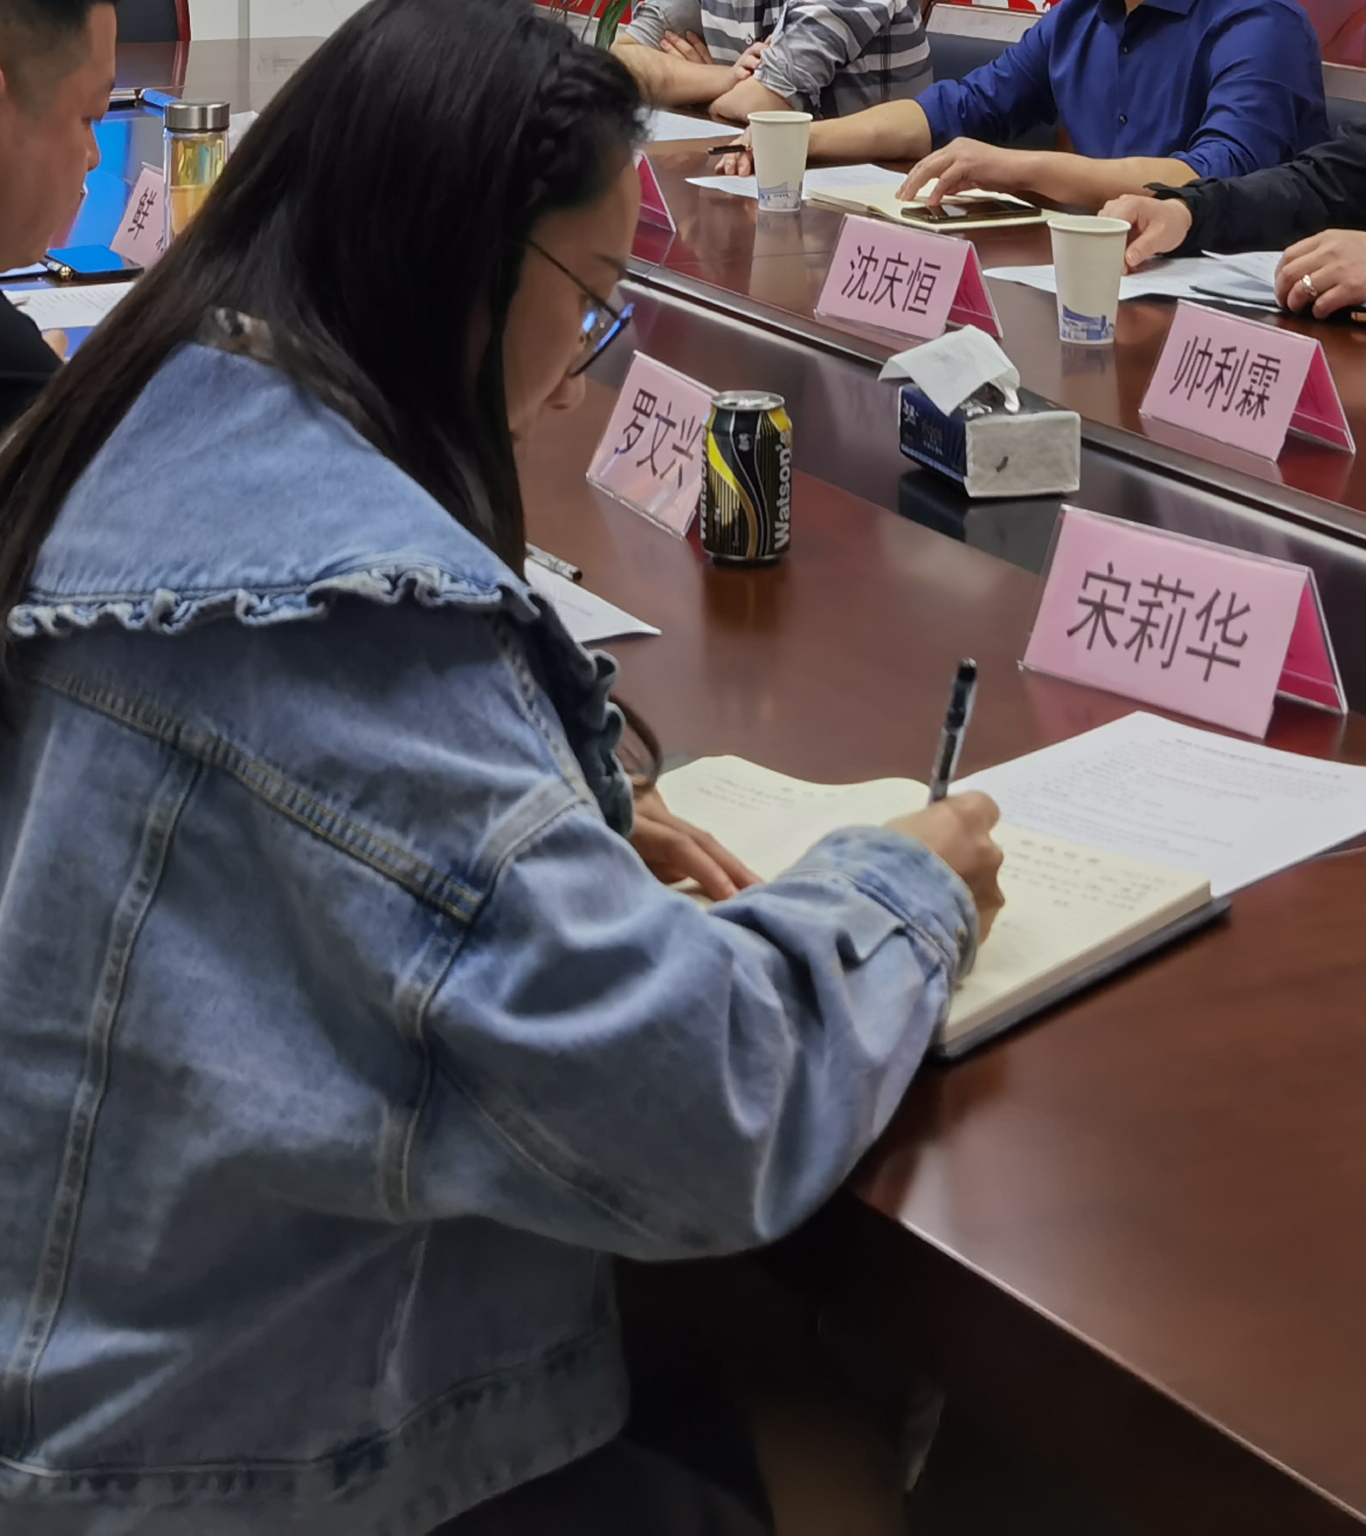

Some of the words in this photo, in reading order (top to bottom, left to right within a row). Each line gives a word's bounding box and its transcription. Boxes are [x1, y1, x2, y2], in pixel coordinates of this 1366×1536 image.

[841, 245, 942, 315] 沈庆恒
[1169, 335, 1282, 421] 帅利霖
[614, 387, 704, 490] 罗文兴
[774, 430, 793, 551] Watson's
[1066, 560, 1251, 683] 宋莉华
